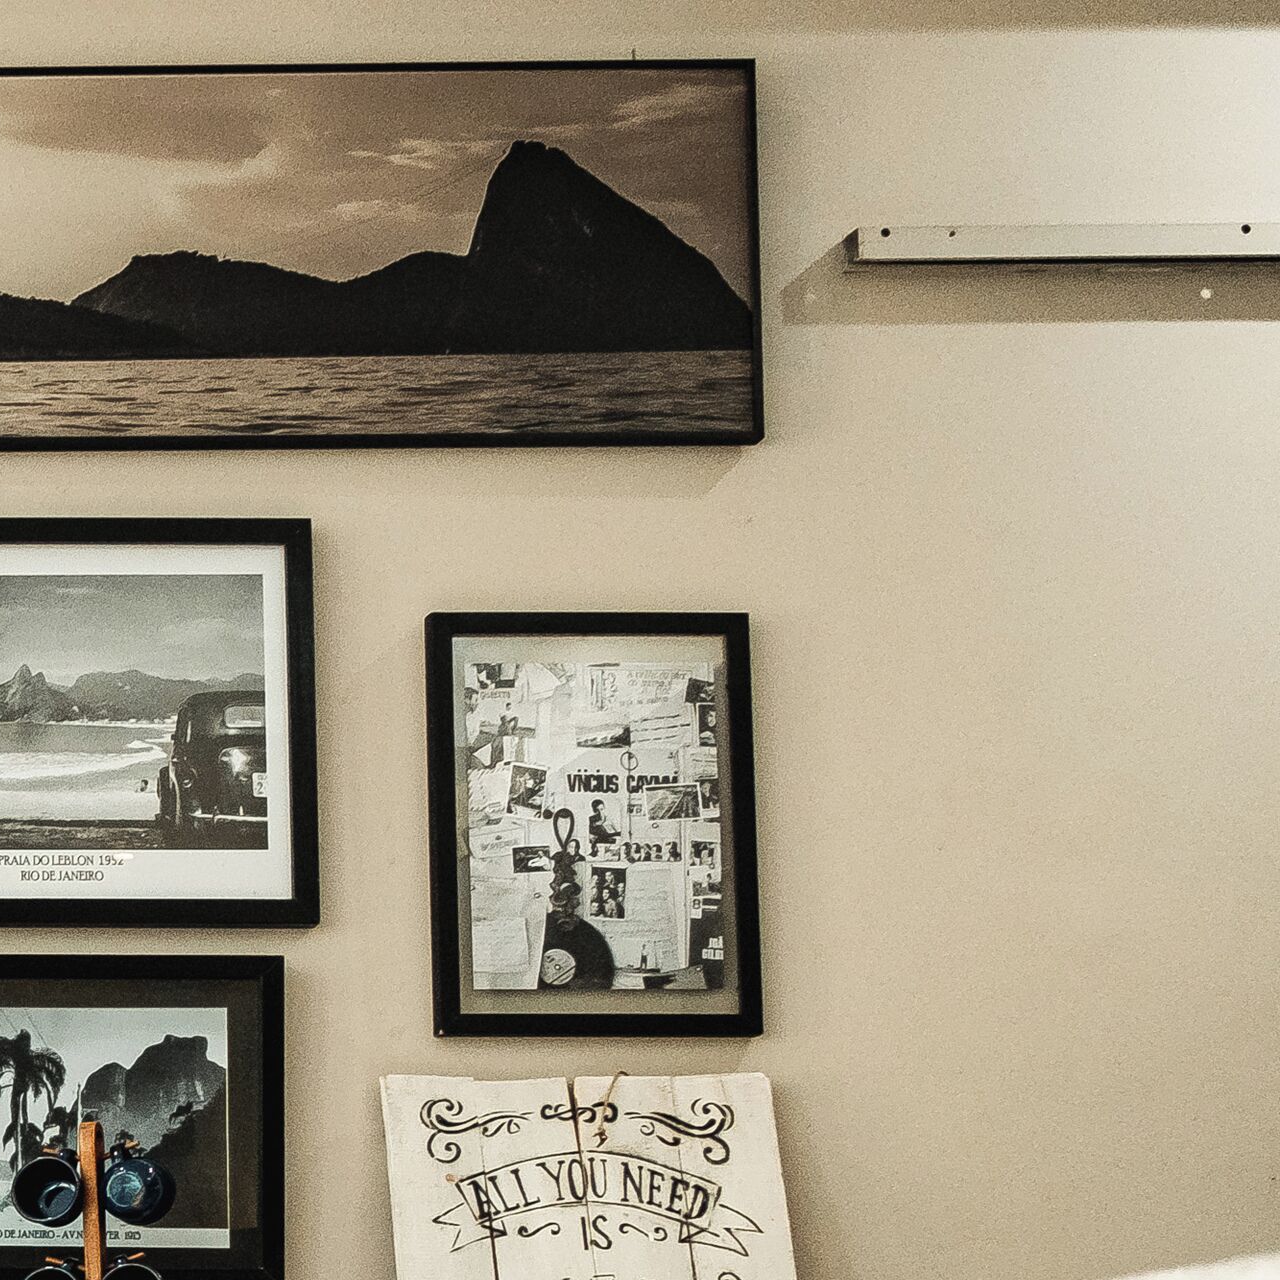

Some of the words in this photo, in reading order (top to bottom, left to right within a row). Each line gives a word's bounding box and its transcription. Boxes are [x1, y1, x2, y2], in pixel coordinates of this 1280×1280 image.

[33, 855, 50, 866] DO
[52, 855, 94, 866] LEBLON
[20, 870, 40, 881] RIO
[42, 870, 56, 881] DE
[59, 870, 104, 881] JANEIRO
[466, 1168, 541, 1221] ALL
[536, 1157, 608, 1202] YOU
[620, 1161, 712, 1220] NEED
[4, 1230, 16, 1238] DE
[18, 1230, 56, 1239] JANEIRO
[580, 1214, 613, 1251] IS
